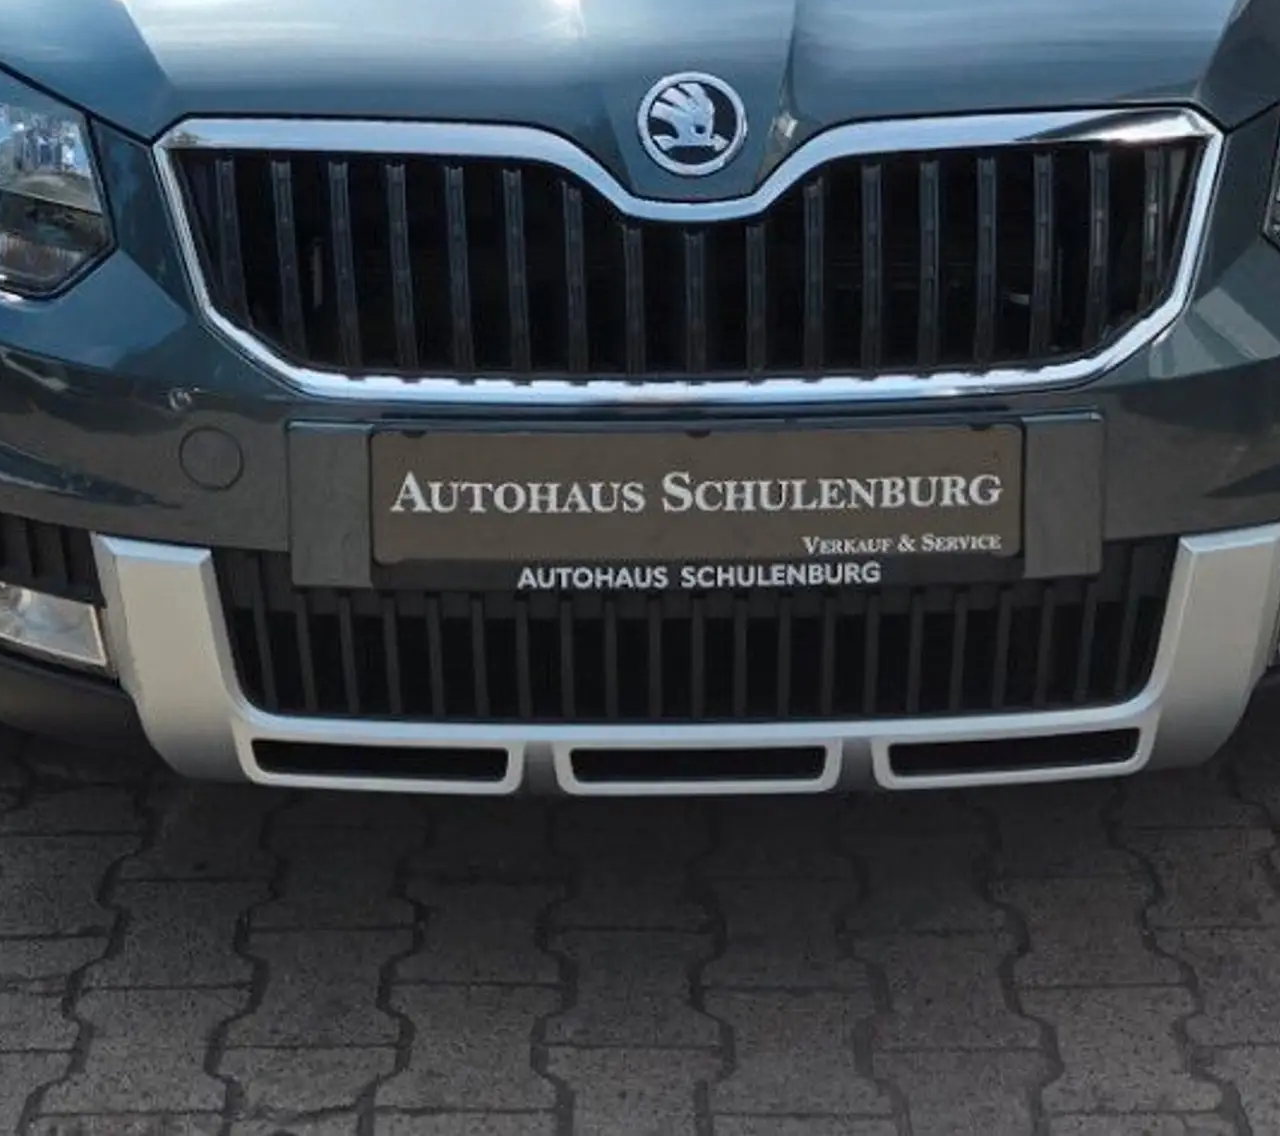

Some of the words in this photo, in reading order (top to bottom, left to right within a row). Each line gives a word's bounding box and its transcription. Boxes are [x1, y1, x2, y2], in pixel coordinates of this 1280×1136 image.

[390, 471, 646, 514] AUTOHAUS
[661, 470, 1003, 512] SCHULENBURG
[802, 535, 893, 555] VERKAUF
[897, 534, 916, 553] &
[921, 532, 1002, 552] SERVICE
[517, 565, 668, 590] AUTOHAUS
[681, 561, 880, 589] SCHULENBURG
